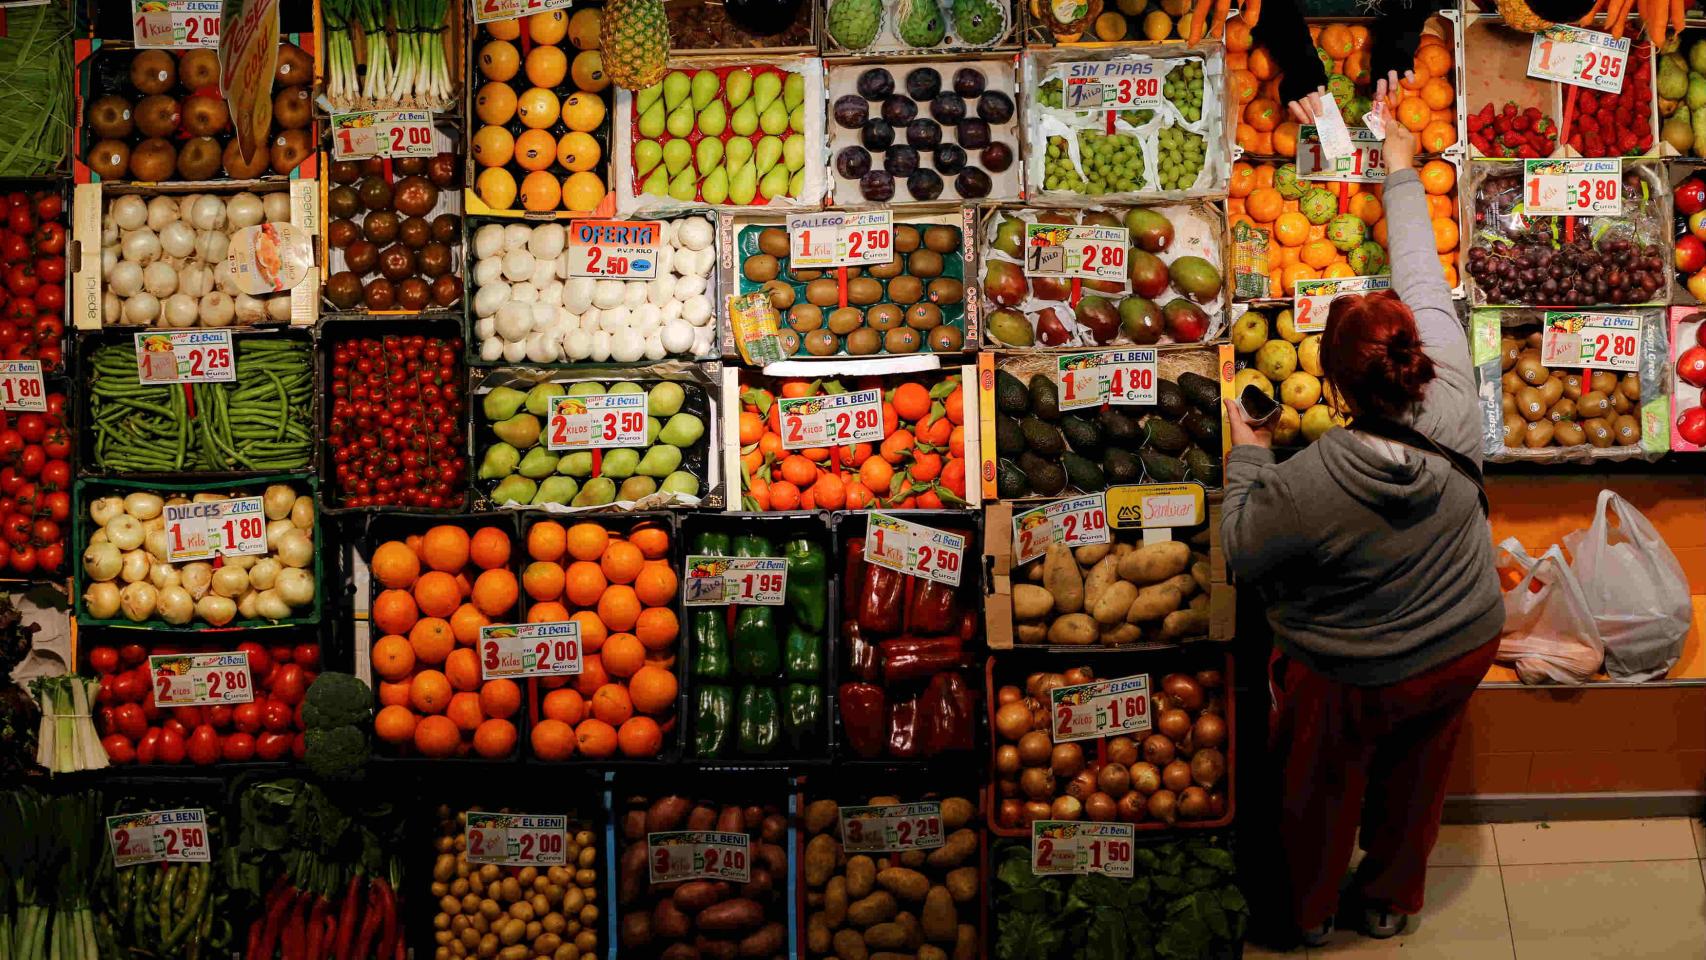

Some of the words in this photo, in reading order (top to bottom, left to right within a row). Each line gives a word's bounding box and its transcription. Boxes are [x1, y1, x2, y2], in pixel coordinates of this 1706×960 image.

[187, 3, 197, 11] El
[198, 1, 219, 11] Beni
[136, 17, 148, 38] 1
[1602, 35, 1625, 49] BENI
[1538, 42, 1552, 69] 1
[1580, 51, 1622, 81] 2'95
[1068, 84, 1082, 107] 1
[1117, 78, 1157, 104] 3'80
[406, 112, 425, 120] Beni
[337, 129, 354, 154] 1
[389, 126, 431, 152] 2'00
[1309, 145, 1322, 173] 1
[1583, 161, 1591, 171] El
[1592, 161, 1613, 171] Beni
[1527, 178, 1540, 206] 1
[1577, 178, 1616, 208] 3'80
[791, 217, 843, 229] GALLEGO
[866, 215, 885, 223] Beni
[579, 224, 652, 245] OFERTA
[798, 230, 812, 257] 1
[848, 230, 889, 258] 2'50
[1105, 230, 1121, 239] Beni
[585, 247, 628, 276] 2,50
[1028, 246, 1042, 272] 1
[1082, 245, 1124, 272] 2'80
[1369, 278, 1389, 288] Beni
[1296, 297, 1312, 323] 2
[1602, 315, 1611, 326] El
[1612, 316, 1633, 327] Beni
[189, 334, 199, 343] El
[200, 332, 223, 342] Beni
[1545, 333, 1558, 361] 1
[1594, 333, 1636, 362] 2'80
[16, 361, 35, 371] Beni
[140, 354, 152, 379] 1
[189, 347, 230, 377] 2'25
[1113, 353, 1125, 362] EL
[1128, 352, 1152, 361] BENI
[1, 378, 41, 404] 1'80
[1061, 372, 1076, 400] 1
[1110, 368, 1152, 398] 4'80
[606, 397, 616, 406] El
[617, 396, 639, 406] Beni
[836, 397, 848, 406] EL
[851, 393, 875, 404] BENI
[551, 415, 567, 445] 2
[603, 411, 643, 441] 3'50
[787, 416, 804, 442] 2
[836, 409, 878, 439] 2'80
[168, 503, 220, 521] DULCES
[232, 503, 239, 513] El
[240, 502, 260, 512] Beni
[1073, 499, 1096, 510] Beni
[169, 523, 185, 551] 1
[222, 517, 262, 550] 1'80
[1062, 510, 1105, 542] 2'40
[873, 529, 886, 556] 1
[932, 533, 942, 542] El
[942, 537, 960, 548] Beni
[1020, 531, 1033, 558] 2
[755, 561, 764, 570] El
[765, 560, 785, 569] Beni
[917, 545, 959, 573] 2'50
[691, 578, 702, 599] 1
[741, 573, 783, 598] 1'95
[538, 627, 547, 635] El
[548, 626, 571, 635] Beni
[218, 656, 226, 665] El
[226, 655, 245, 664] Beni
[484, 641, 499, 670] 3
[535, 639, 577, 670] 2'00
[157, 676, 173, 701] 2
[206, 670, 247, 698] 2'80
[1110, 683, 1120, 693] El
[1121, 681, 1142, 691] Beni
[1057, 707, 1072, 734] 2
[1107, 695, 1146, 729] 1'60
[161, 813, 174, 823] EL
[176, 812, 200, 822] BENI
[918, 804, 935, 814] Beni
[522, 817, 535, 827] EL
[537, 817, 561, 828] BENI
[847, 819, 864, 844] 3
[1109, 825, 1128, 835] Beni
[115, 829, 131, 856] 2
[164, 827, 204, 855] 2'50
[469, 829, 484, 855] 2
[519, 833, 561, 861] 2'00
[705, 833, 717, 843] EL
[720, 835, 744, 845] BENI
[654, 847, 670, 874] 3
[704, 847, 745, 874] 2'40
[1037, 840, 1054, 867] 2
[1089, 841, 1130, 869] 1'50
